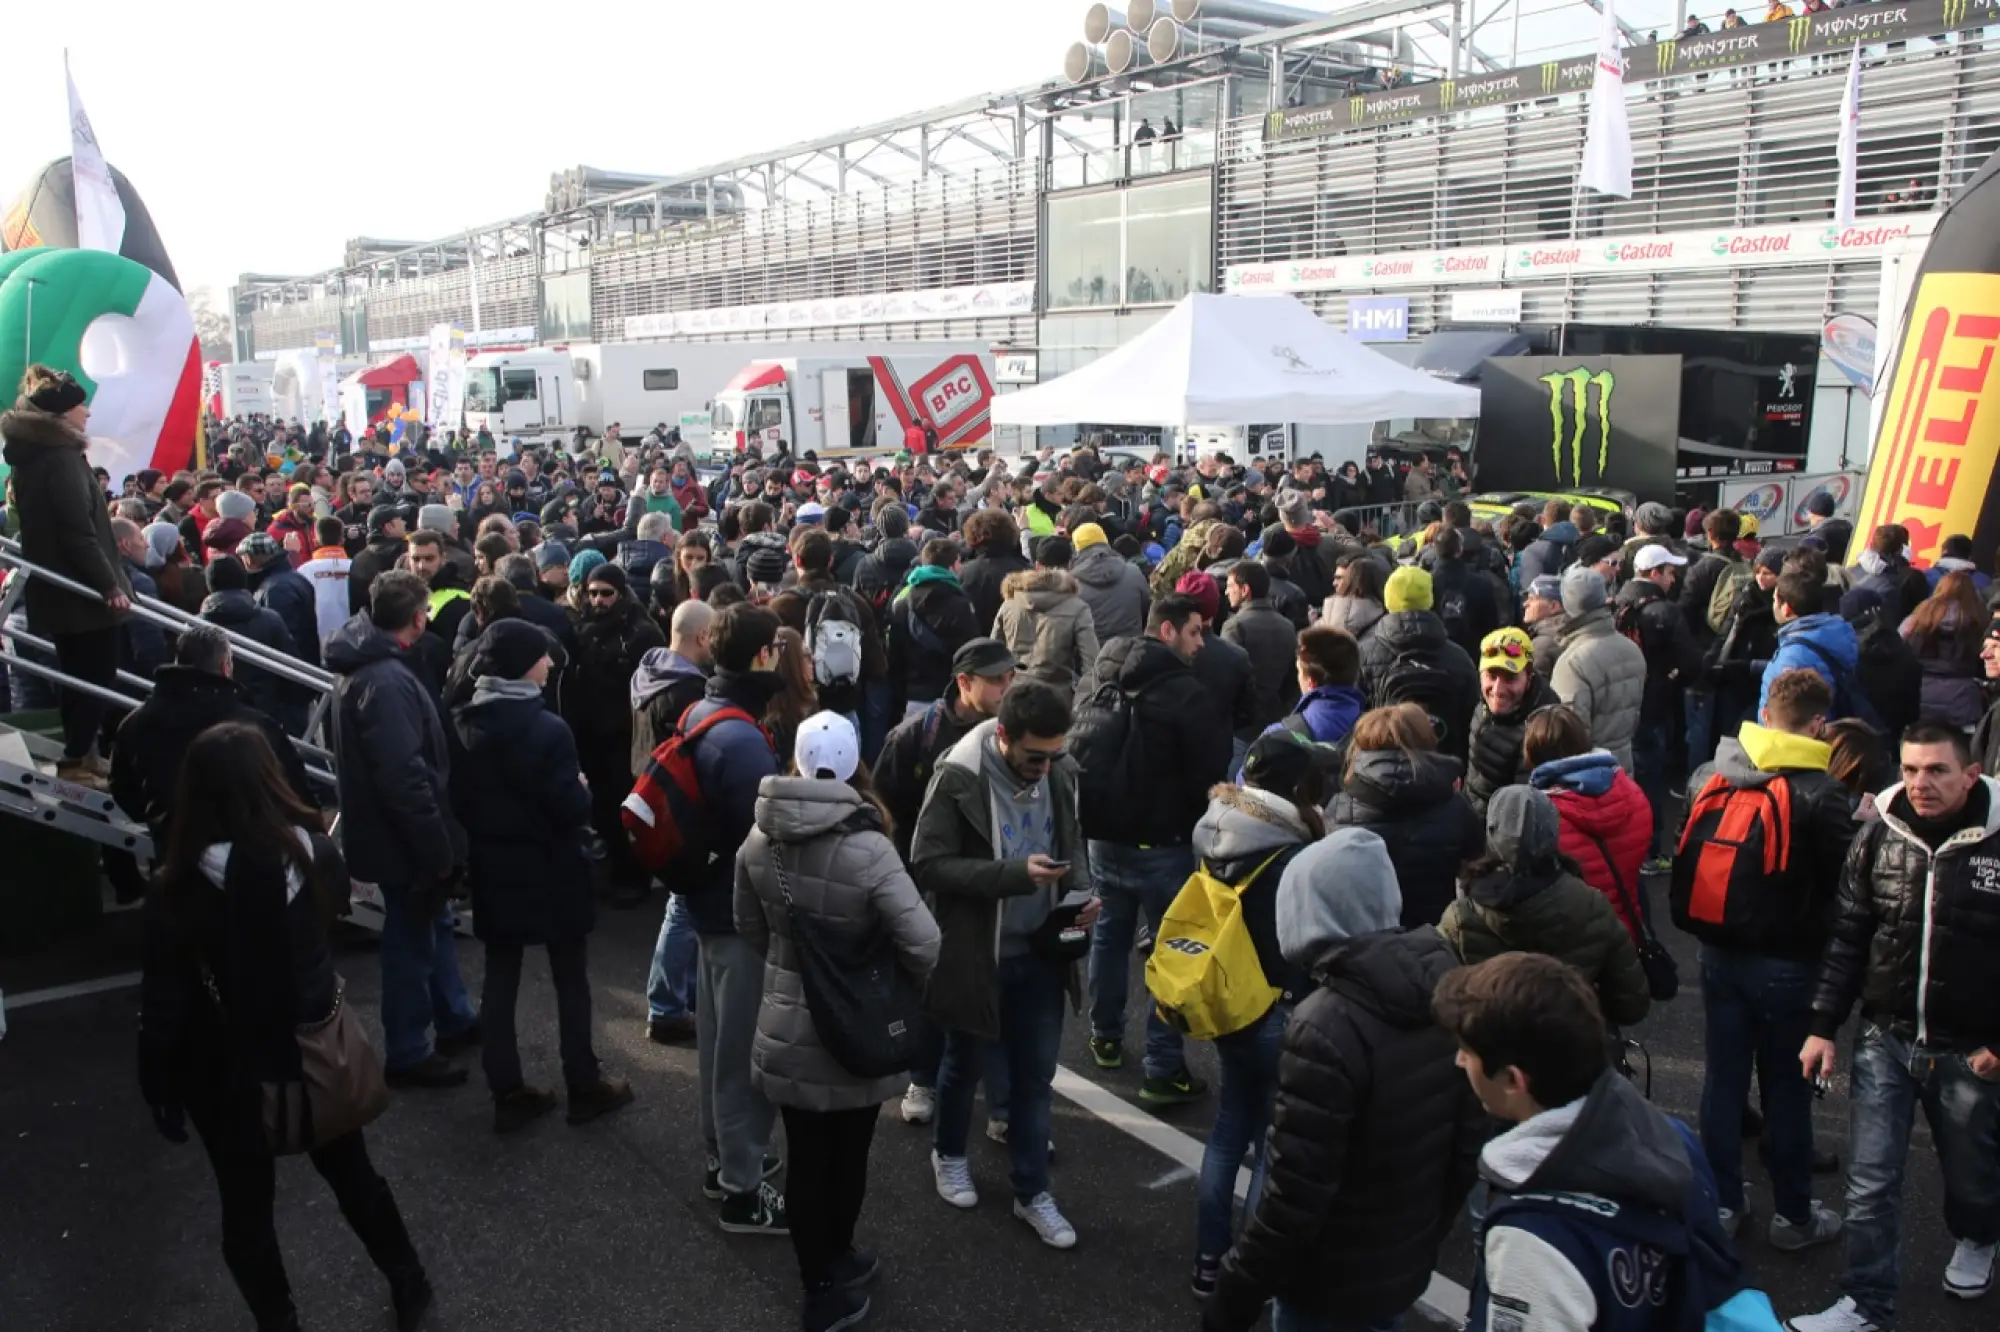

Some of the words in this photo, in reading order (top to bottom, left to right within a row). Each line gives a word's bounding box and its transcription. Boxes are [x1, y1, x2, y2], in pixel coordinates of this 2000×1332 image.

[1814, 8, 1908, 36] MONSTER
[1679, 35, 1759, 60] MONSTER
[1561, 56, 1631, 81] MONR
[1458, 76, 1519, 98] MONSTER
[1366, 95, 1421, 114] MONSTER
[1285, 108, 1333, 126] MONSTER
[1620, 242, 1674, 261] Castrol
[1730, 233, 1791, 254] Castrol
[1444, 256, 1489, 272] Castrol
[1532, 248, 1581, 266] Castrol
[1241, 270, 1274, 285] Castrol
[1301, 266, 1336, 281] Castrol
[1374, 260, 1414, 277] Castrol
[1353, 308, 1402, 330] HMI
[932, 376, 972, 413] BRC
[1766, 403, 1803, 413] PEUGEOT
[1164, 937, 1210, 955] 46
